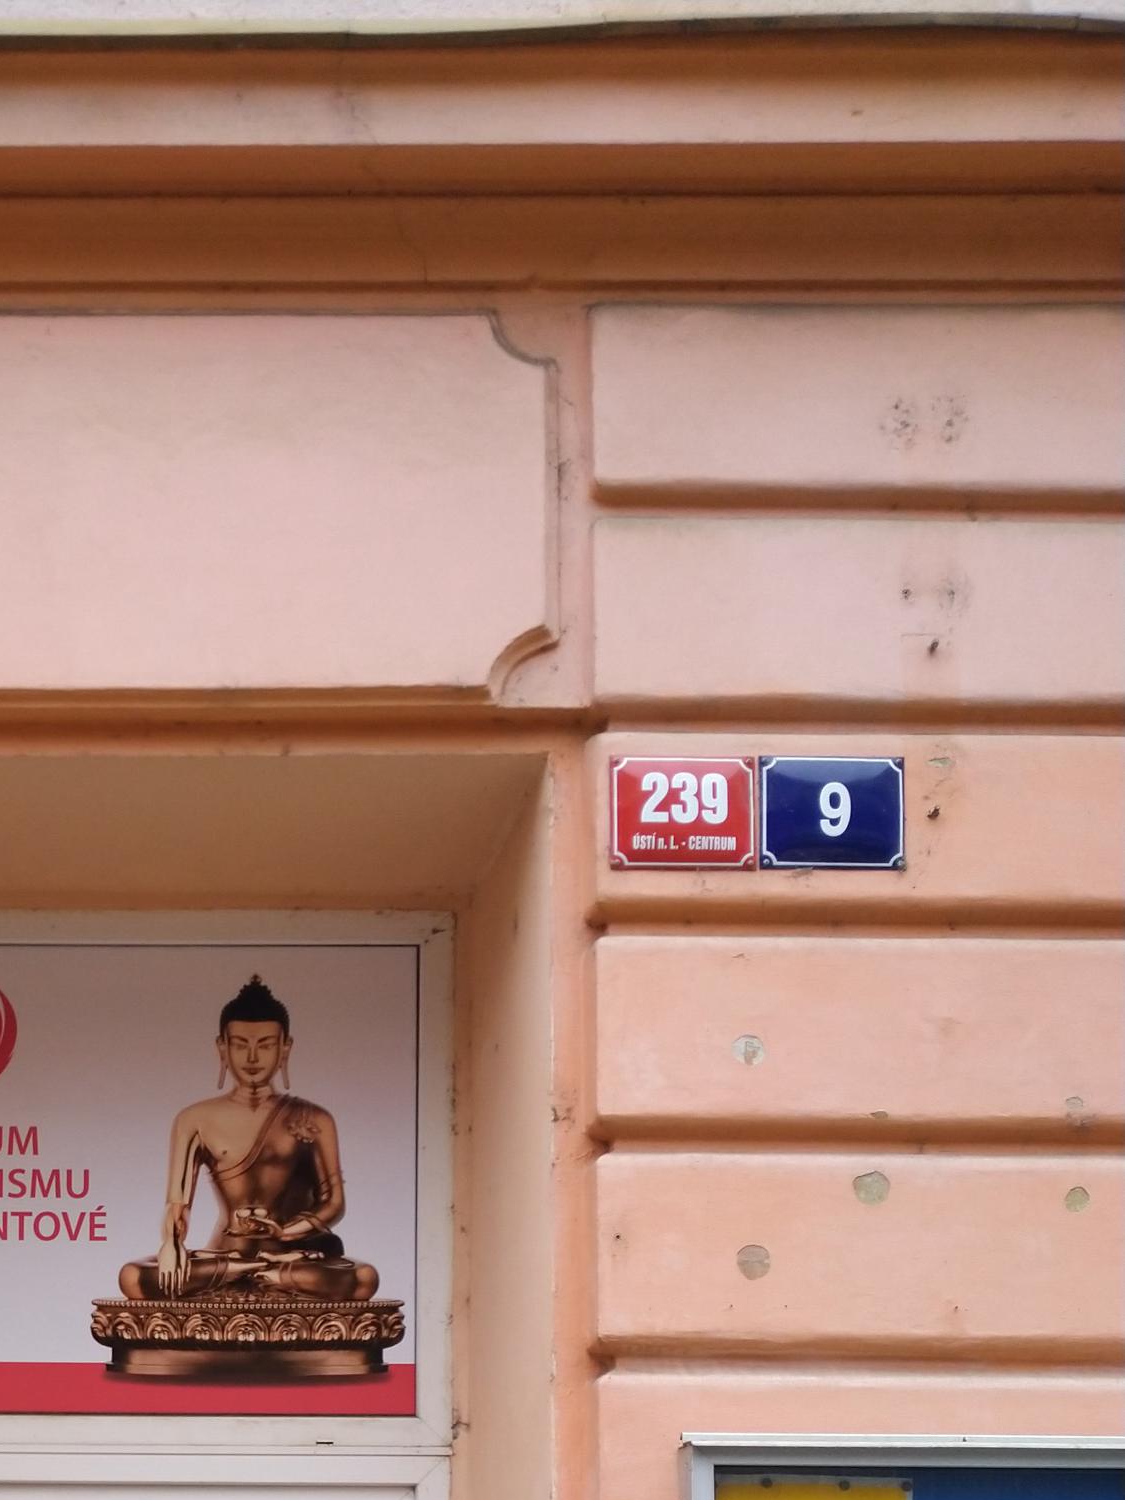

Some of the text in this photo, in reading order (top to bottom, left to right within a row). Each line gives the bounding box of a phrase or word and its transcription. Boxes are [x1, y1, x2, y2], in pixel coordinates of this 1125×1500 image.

[640, 771, 728, 825] 239
[819, 782, 852, 837] 9
[632, 832, 656, 850] ÚSTÍ
[657, 838, 667, 850] n.
[669, 836, 679, 850] L.
[688, 835, 736, 851] CENTRUM
